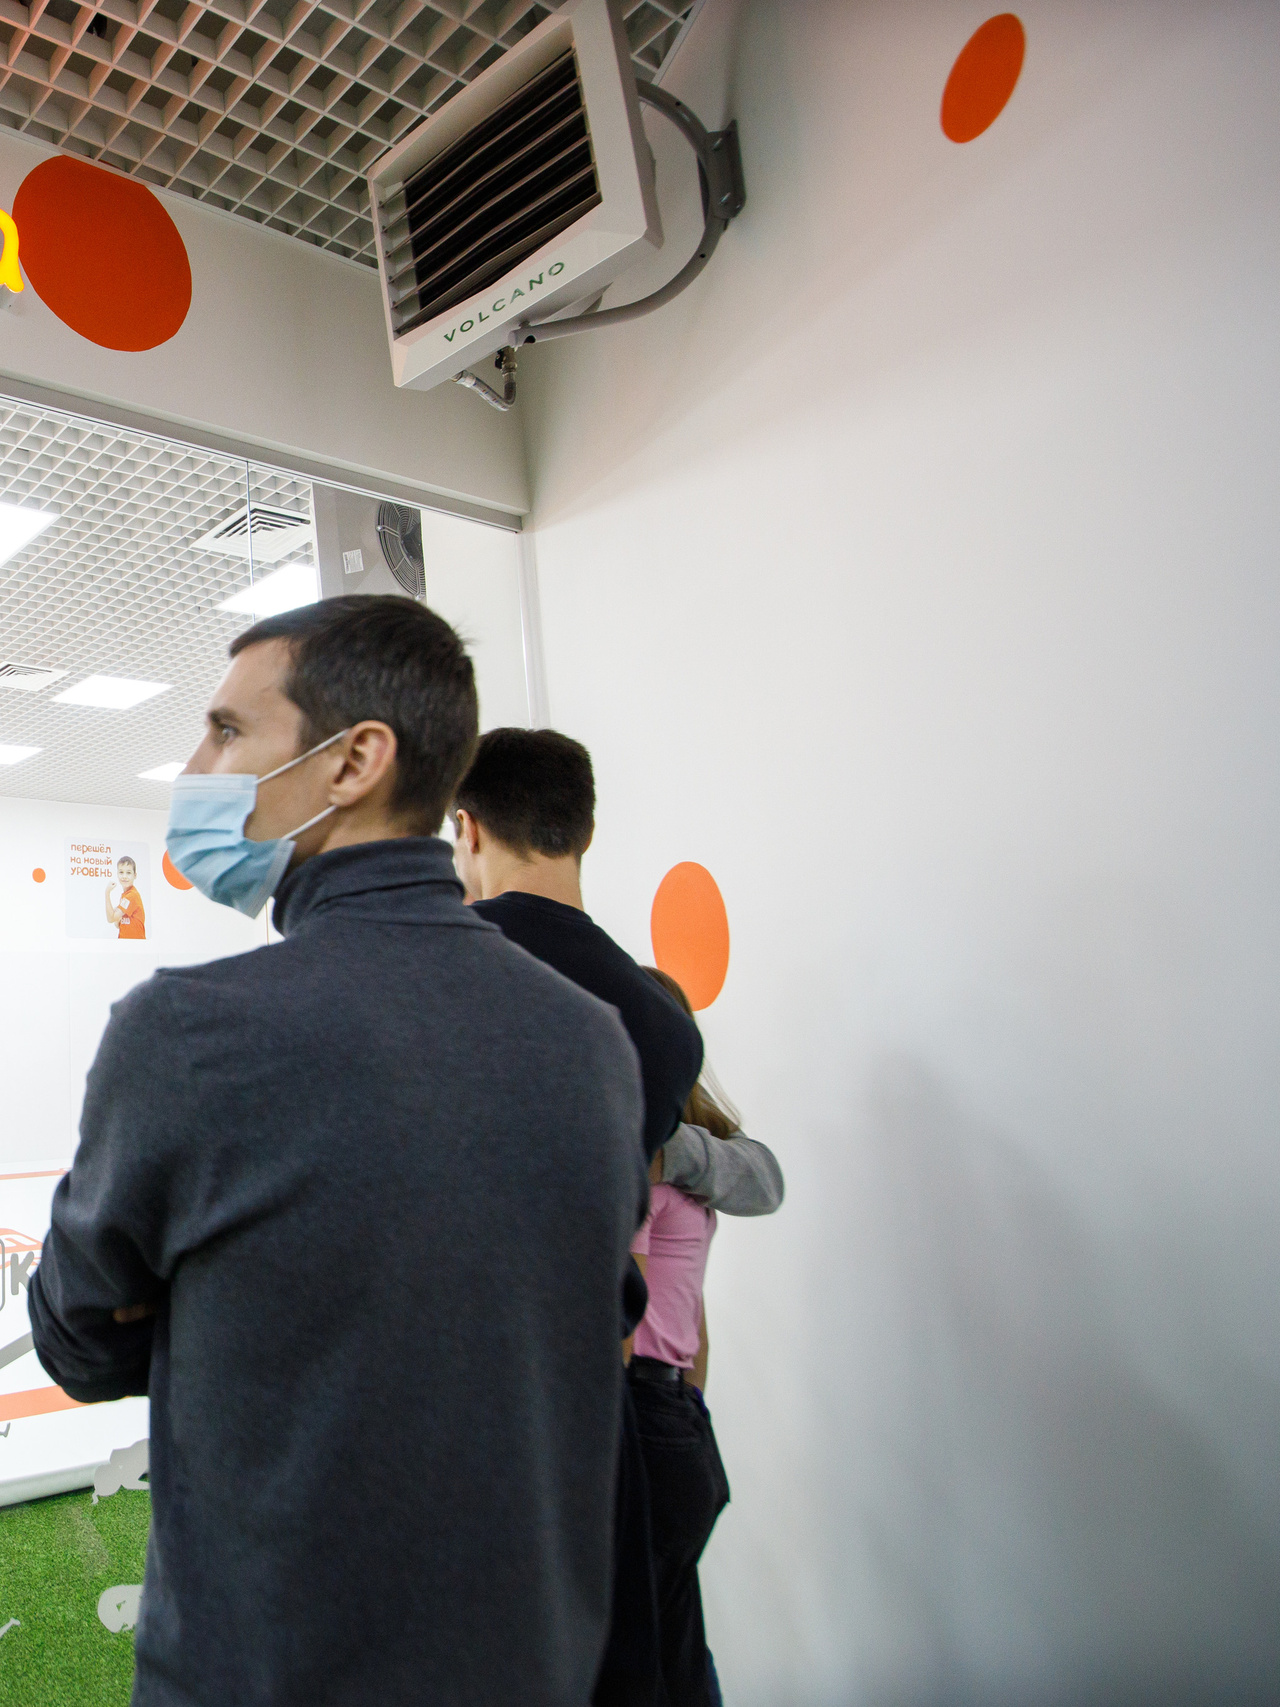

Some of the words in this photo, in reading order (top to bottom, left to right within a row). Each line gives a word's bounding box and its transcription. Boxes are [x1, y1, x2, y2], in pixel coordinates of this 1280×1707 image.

[443, 261, 565, 343] VOLCANO
[70, 843, 112, 855] перешёл
[70, 856, 82, 864] на
[83, 857, 113, 866] новый
[70, 867, 113, 878] УРОВЕНЬ
